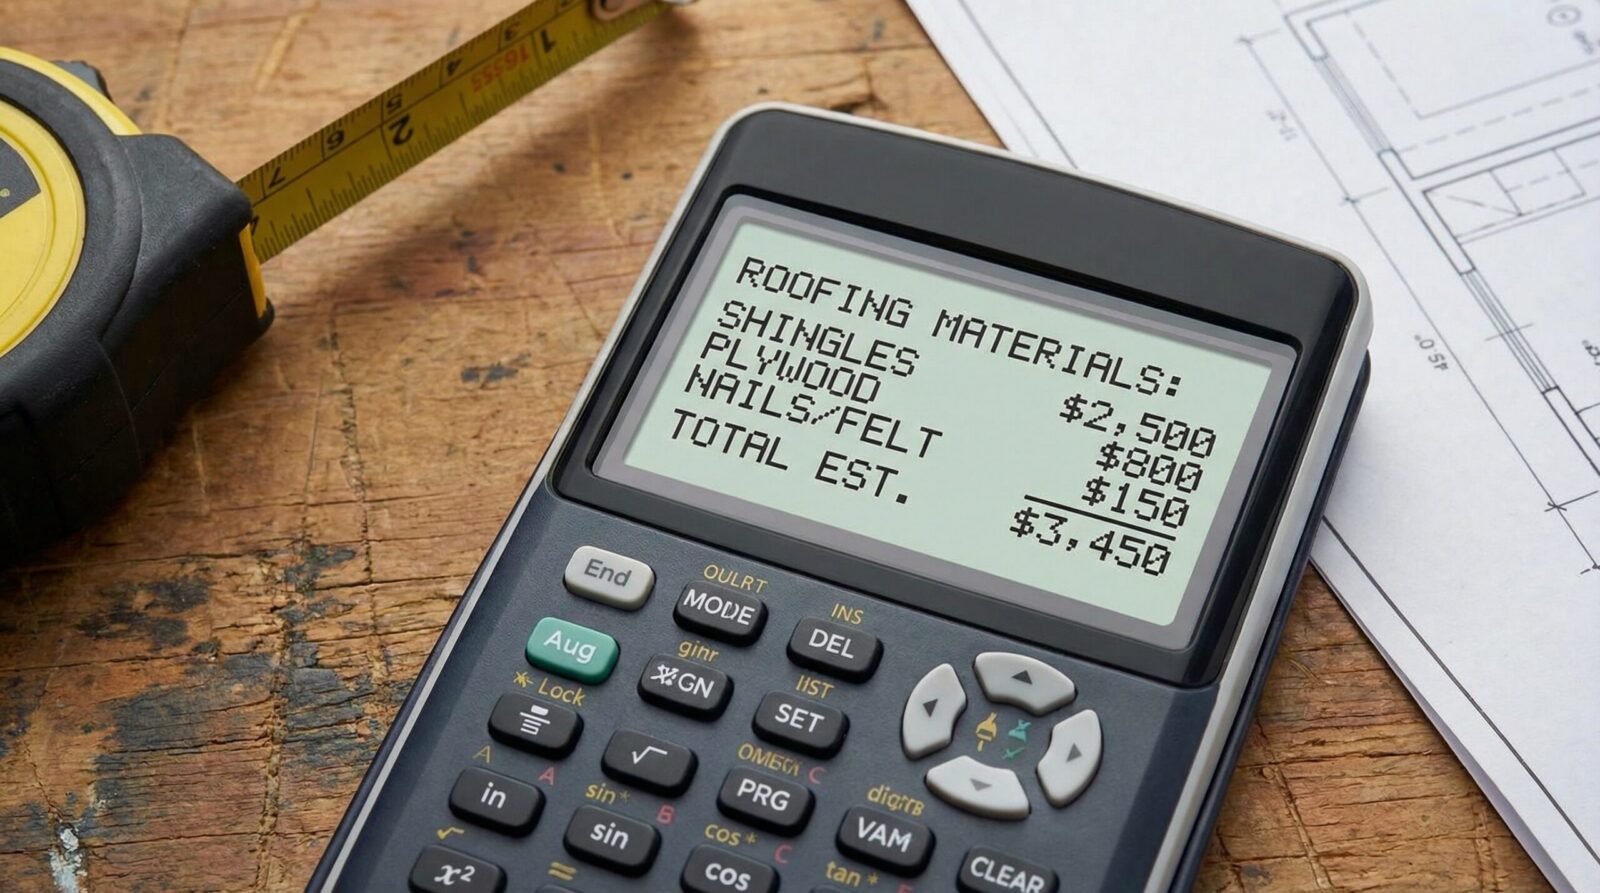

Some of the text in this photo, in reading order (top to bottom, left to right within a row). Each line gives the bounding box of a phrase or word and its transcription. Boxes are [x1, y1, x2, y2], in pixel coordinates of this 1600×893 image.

[389, 114, 414, 146] 2
[736, 257, 1182, 398] ROOFING MATERIALS:
[717, 301, 1216, 458] SHINGLES $2,500
[700, 332, 1204, 493] PLYWOOD $800
[684, 365, 1190, 529] NAILS/FELT $150
[671, 409, 1171, 577] TOTAL EST. $3,450
[584, 559, 632, 587] End
[683, 589, 755, 625] MODE
[831, 603, 864, 625] INS
[544, 631, 596, 664] Aug
[809, 628, 854, 659] DEL
[538, 679, 586, 707] Lock
[774, 703, 825, 733] SET
[473, 745, 491, 764] A
[538, 767, 555, 785] A
[808, 766, 826, 784] C
[737, 778, 791, 811] PRG
[590, 823, 629, 850] sin
[858, 816, 912, 853] VAM
[774, 844, 793, 864] C
[705, 863, 751, 891] cos
[970, 856, 1045, 893] CLEAR
